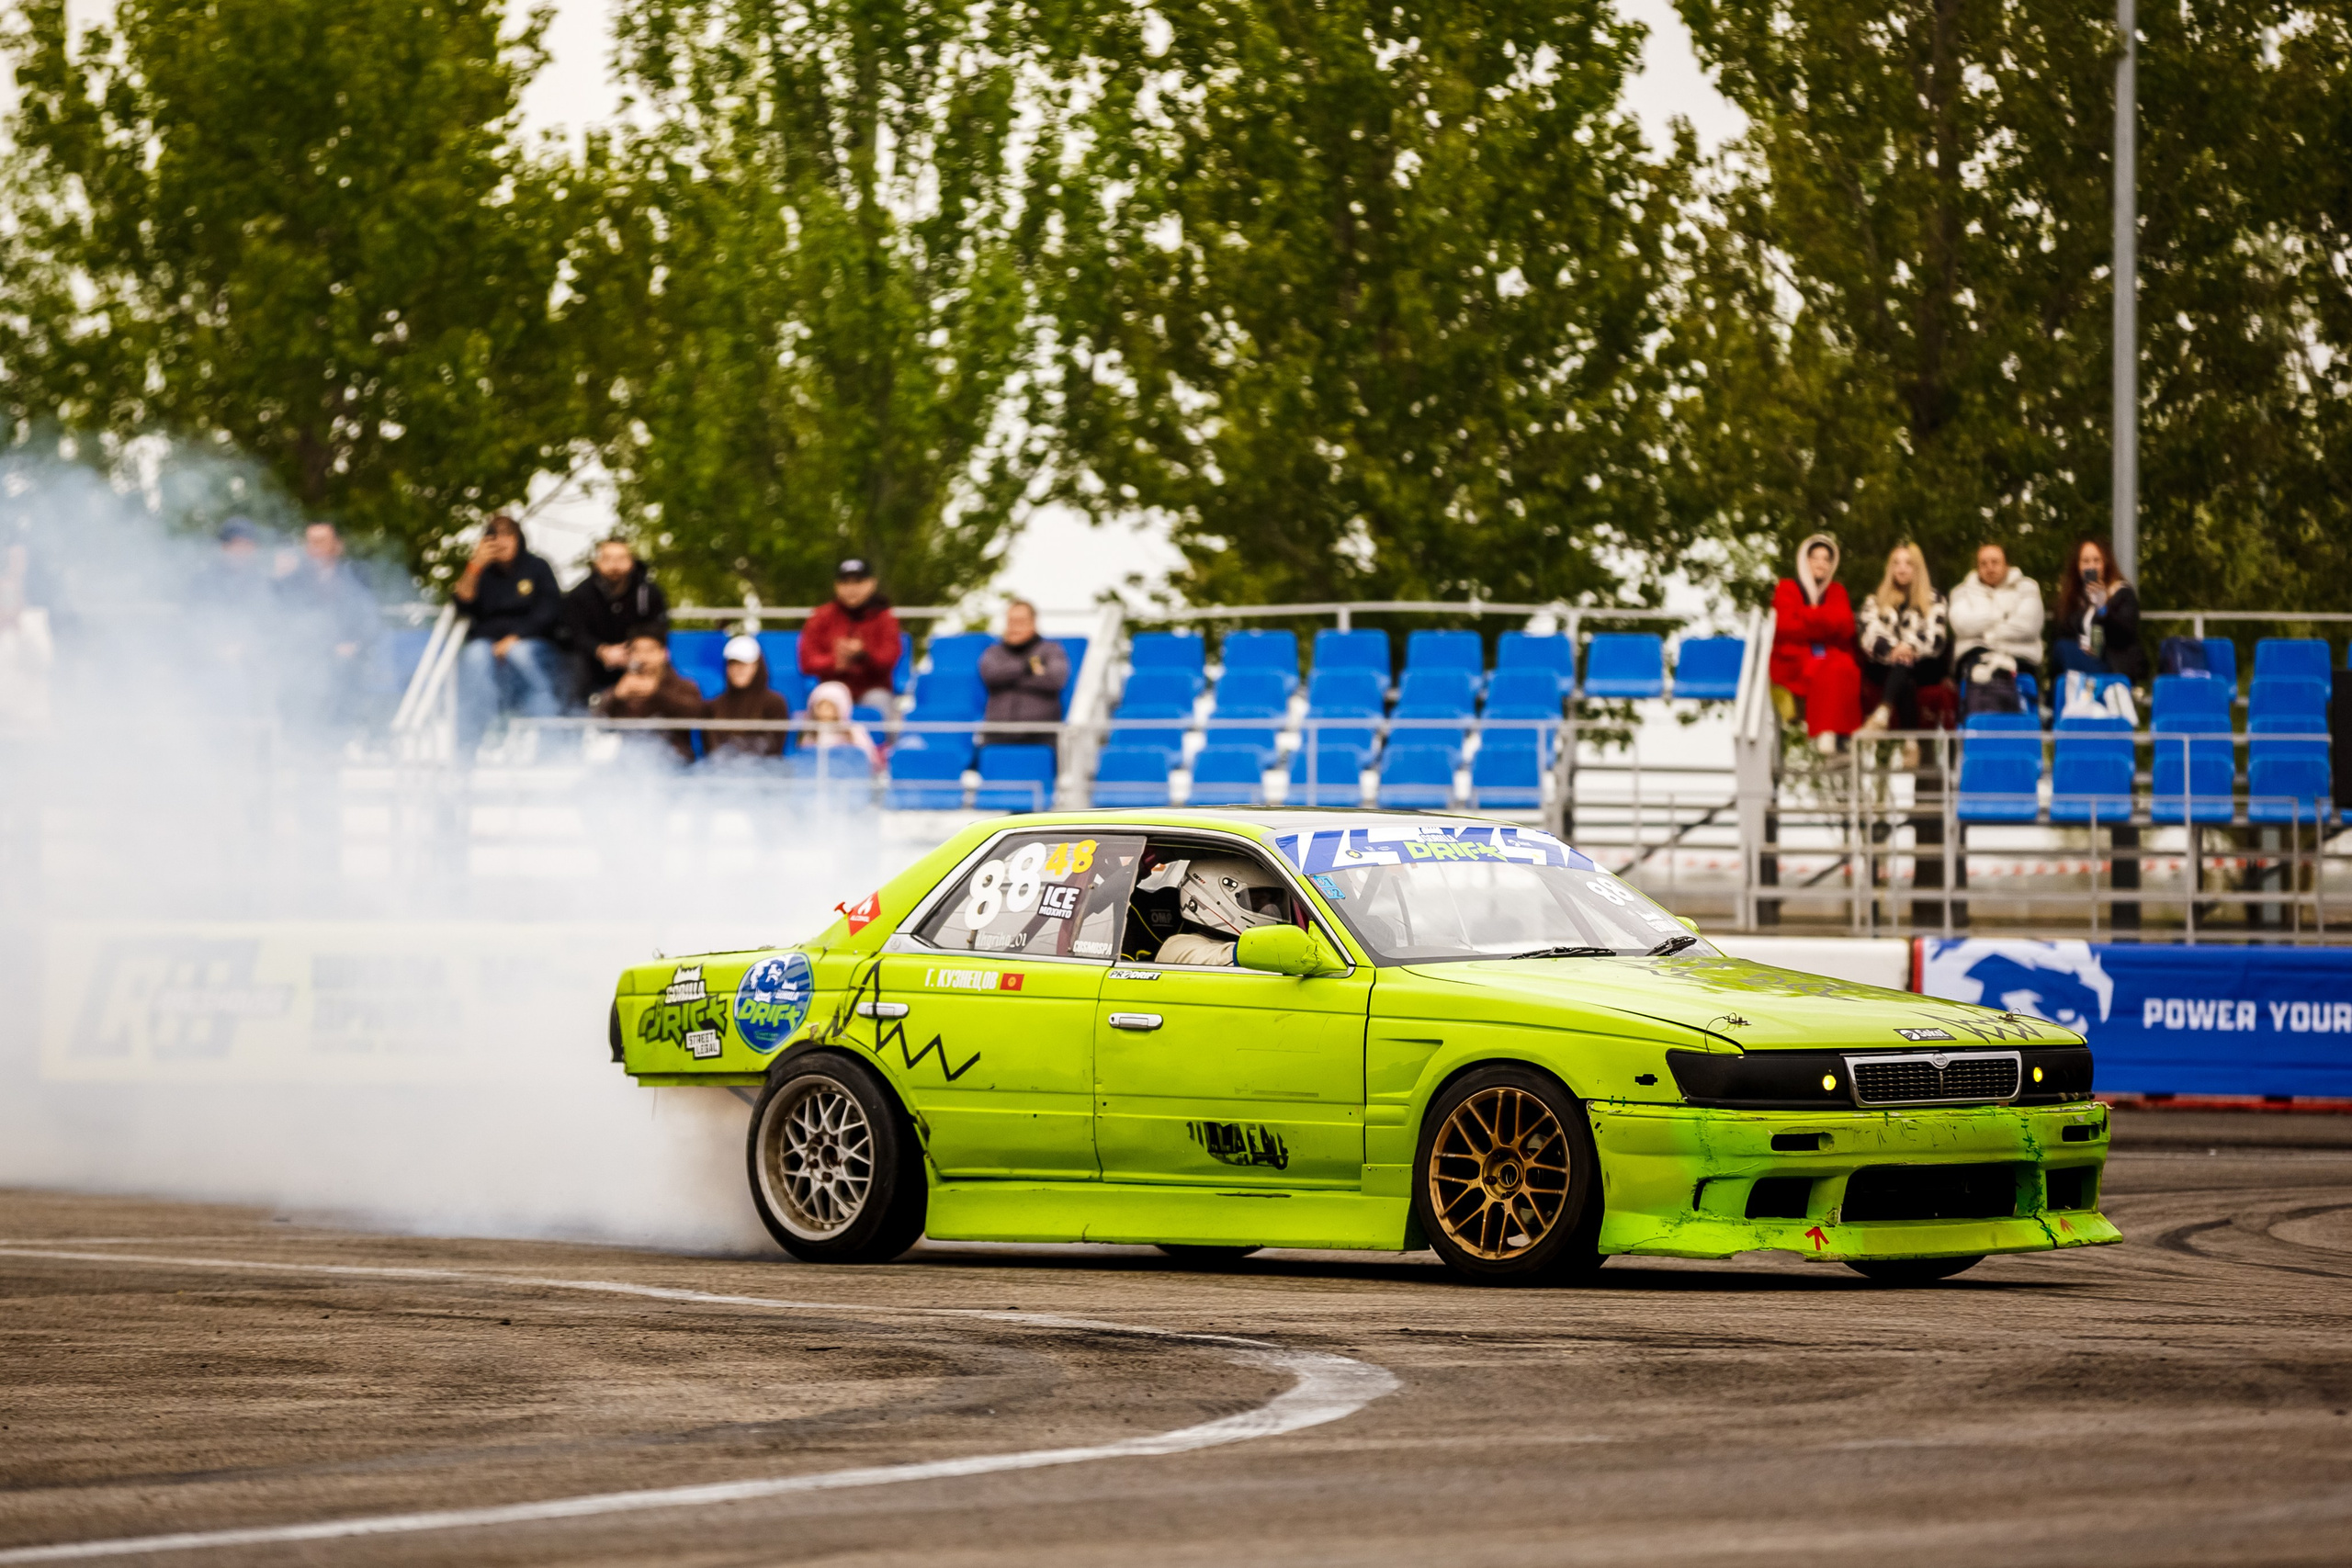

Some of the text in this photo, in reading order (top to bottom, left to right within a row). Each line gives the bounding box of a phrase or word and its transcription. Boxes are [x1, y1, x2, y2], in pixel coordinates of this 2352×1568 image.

[1045, 839, 1097, 876] 48
[965, 841, 1046, 930] 88
[1043, 886, 1080, 909] ICE
[1586, 876, 1634, 907] 88
[937, 969, 999, 991] КУЗНЕЦОВ
[2143, 998, 2352, 1033] POWER YOUR
[688, 1032, 714, 1045] STREET
[695, 1043, 718, 1055] LEGAL
